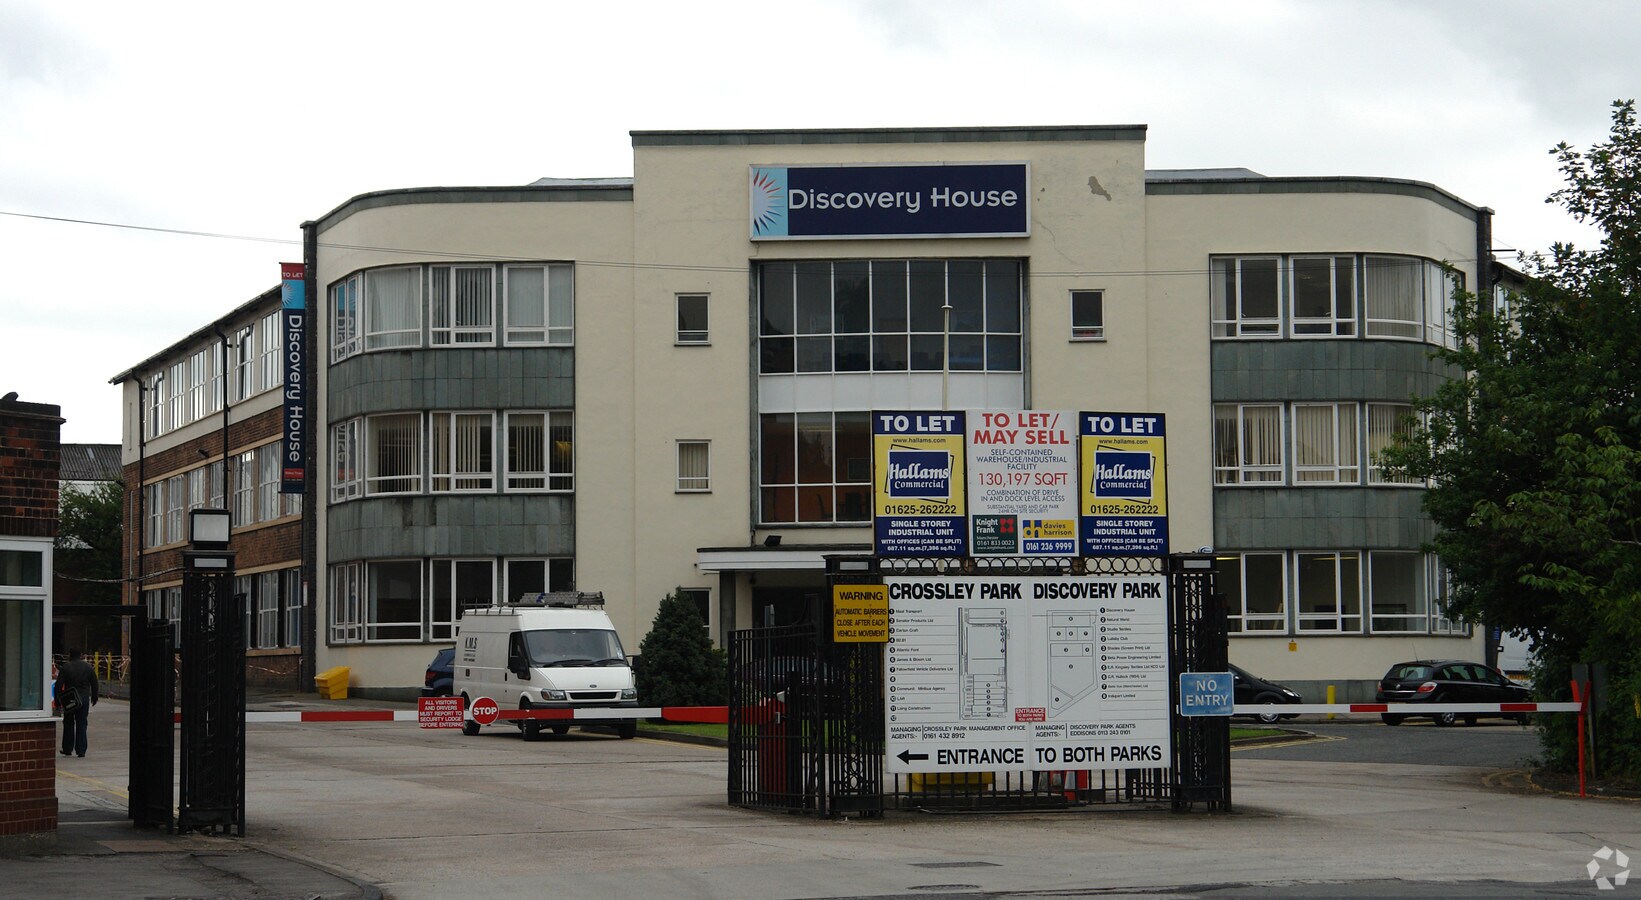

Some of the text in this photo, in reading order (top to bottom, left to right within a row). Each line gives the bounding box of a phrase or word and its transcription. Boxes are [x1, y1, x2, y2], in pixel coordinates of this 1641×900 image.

[788, 187, 1018, 213] Discovery House
[286, 315, 302, 399] Discovery
[880, 415, 955, 431] TO LET
[982, 413, 1059, 429] TO LET/
[1088, 417, 1156, 433] TO LET
[289, 406, 303, 462] House
[974, 430, 1069, 445] MAY SELL
[889, 464, 949, 480] Hallams
[1095, 464, 1152, 480] Hallams
[894, 480, 944, 489] Commercial
[979, 473, 1068, 487] 130,197 SQFT
[1100, 480, 1146, 489] Commercial
[885, 505, 956, 514] 01625-262222
[1090, 505, 1158, 514] 01625-262222
[1026, 542, 1072, 550] 0161 236 9999
[839, 592, 883, 600] WARNING
[890, 583, 1022, 599] CROSSLEY PARK
[1034, 582, 1161, 599] DISCOVERY PARK
[1196, 680, 1217, 691] NO
[1186, 695, 1229, 706] ENTRY
[474, 707, 497, 715] STOP
[937, 746, 1162, 764] ENTRANCE TO BOTH PARKS
